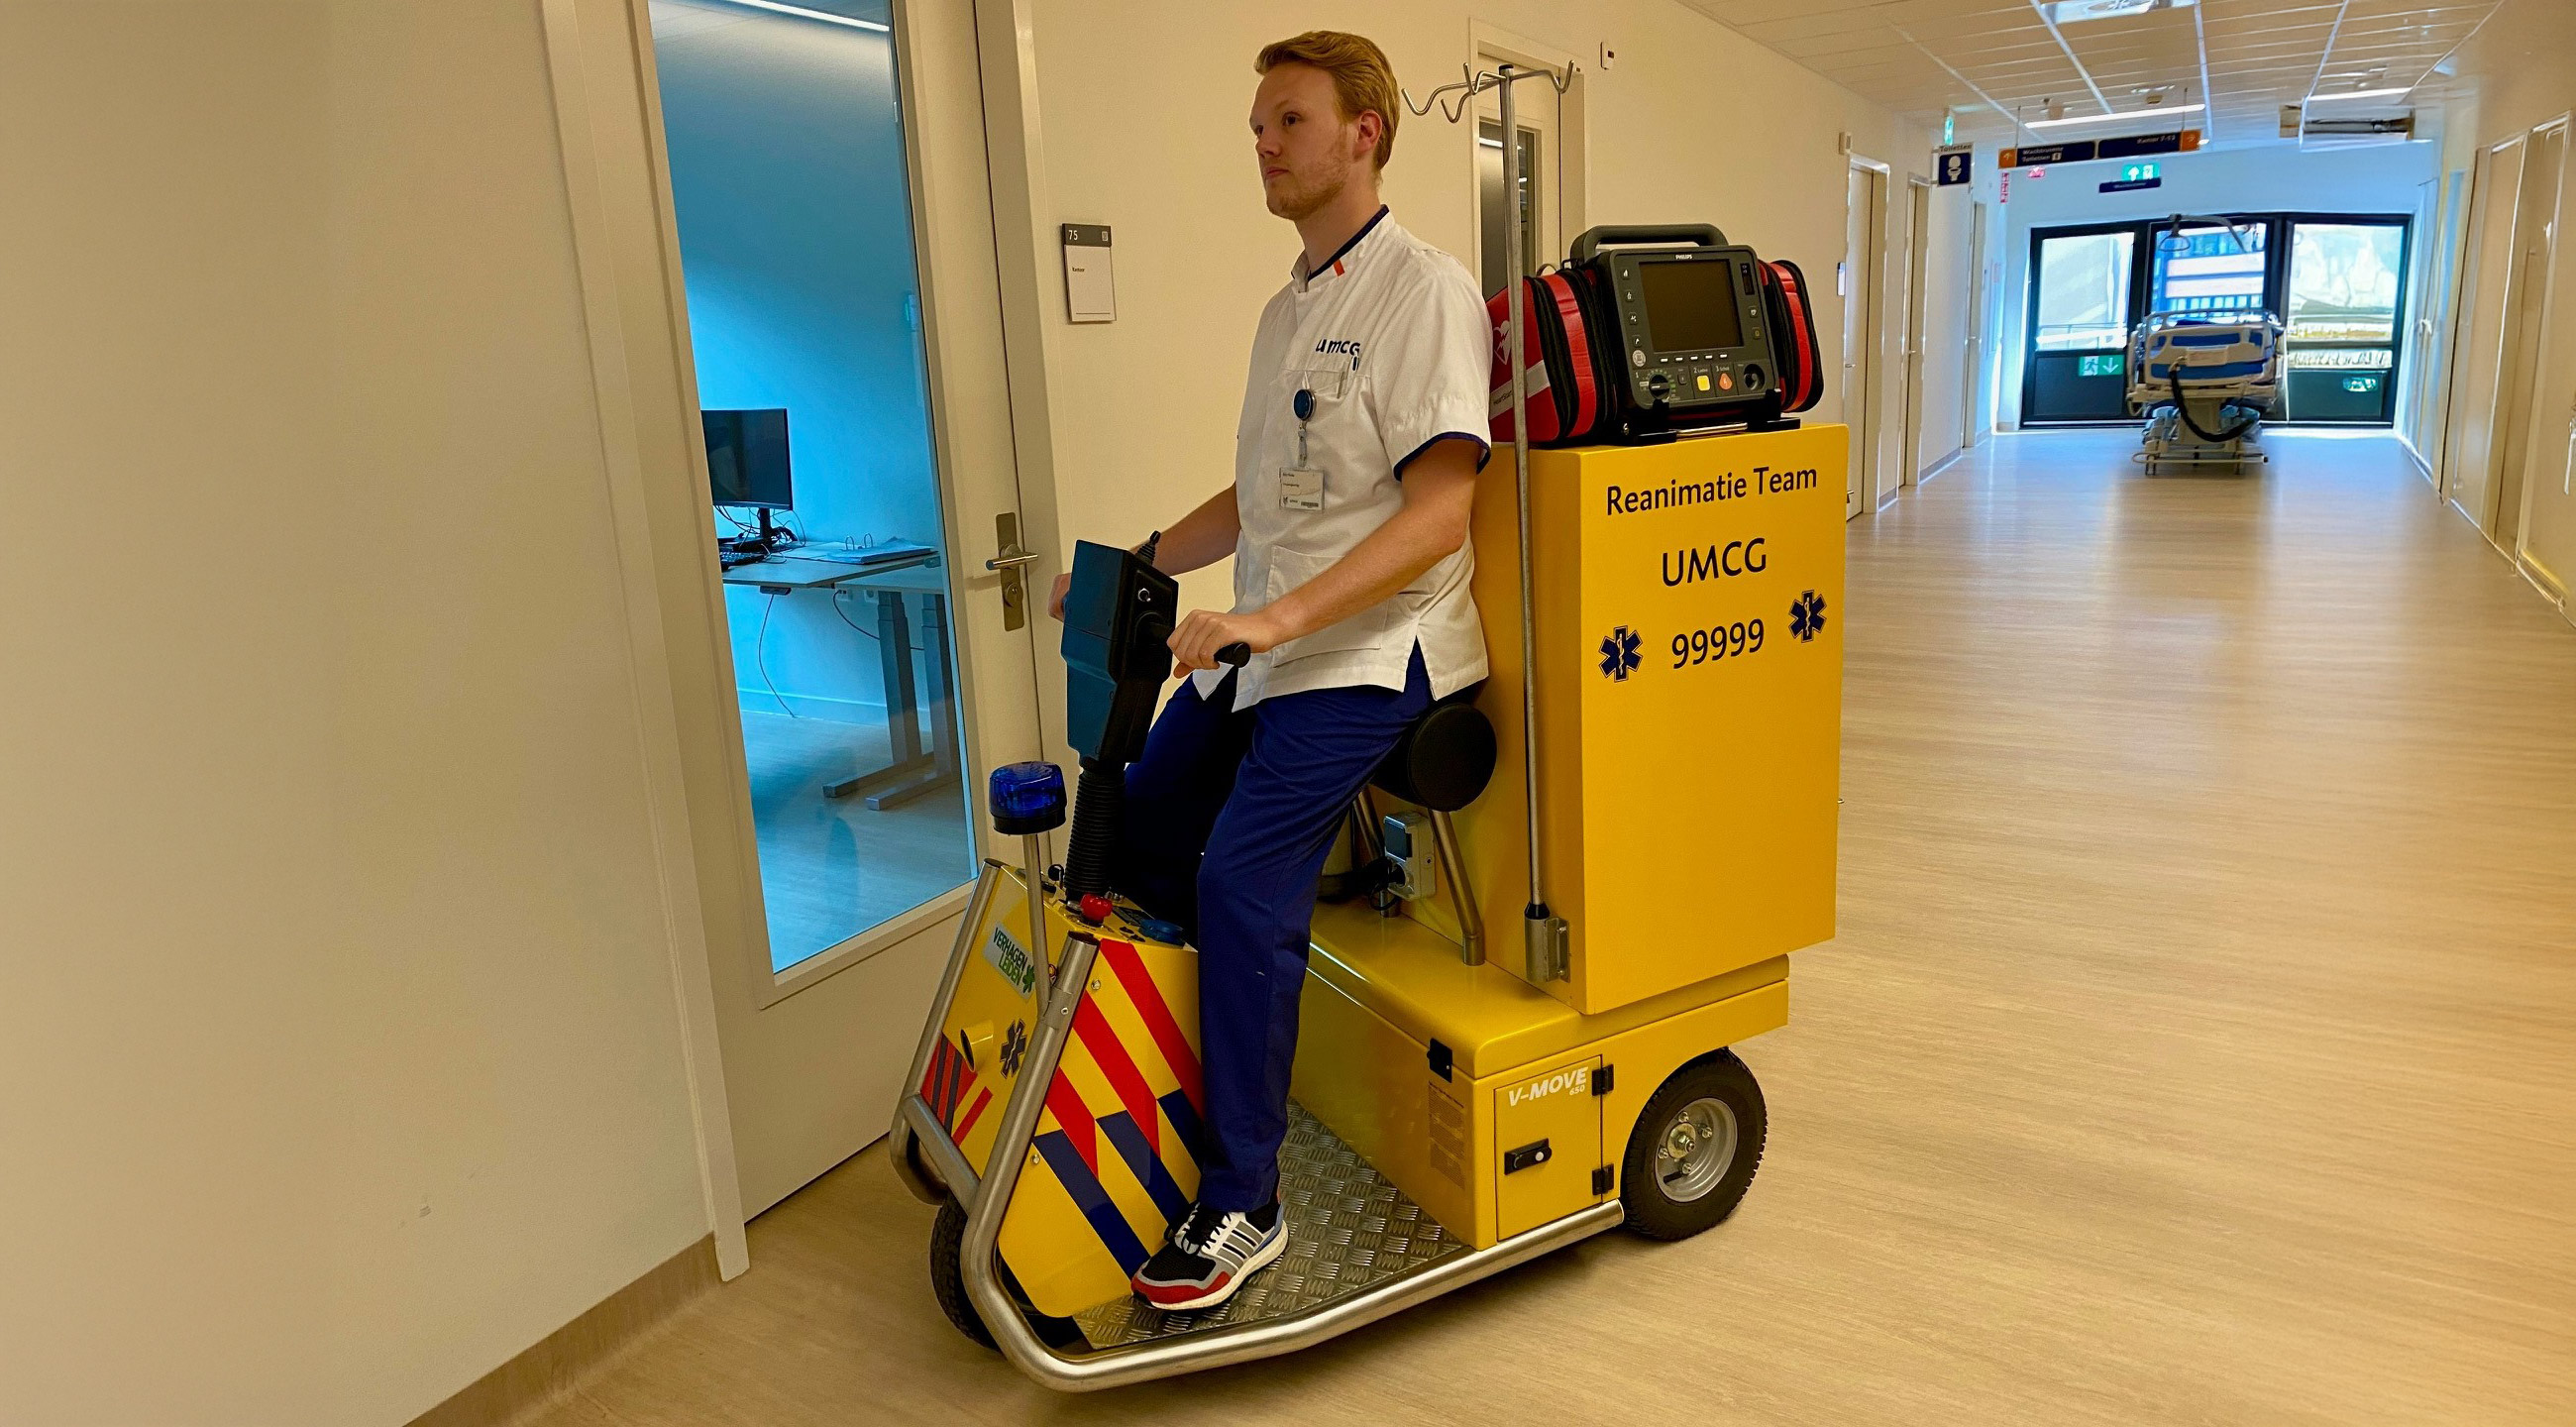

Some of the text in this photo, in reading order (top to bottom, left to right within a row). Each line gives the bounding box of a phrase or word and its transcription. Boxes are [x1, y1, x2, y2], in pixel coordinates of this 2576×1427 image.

[1068, 229, 1078, 241] 75
[1606, 466, 1817, 515] Reanimatie Team
[1662, 537, 1767, 587] UMCG
[1671, 618, 1765, 670] 99999
[993, 927, 1028, 971] VERHAGEN
[999, 951, 1023, 986] LEIDEN
[1508, 1066, 1588, 1107] V-MOVE
[1569, 1084, 1585, 1096] 650
